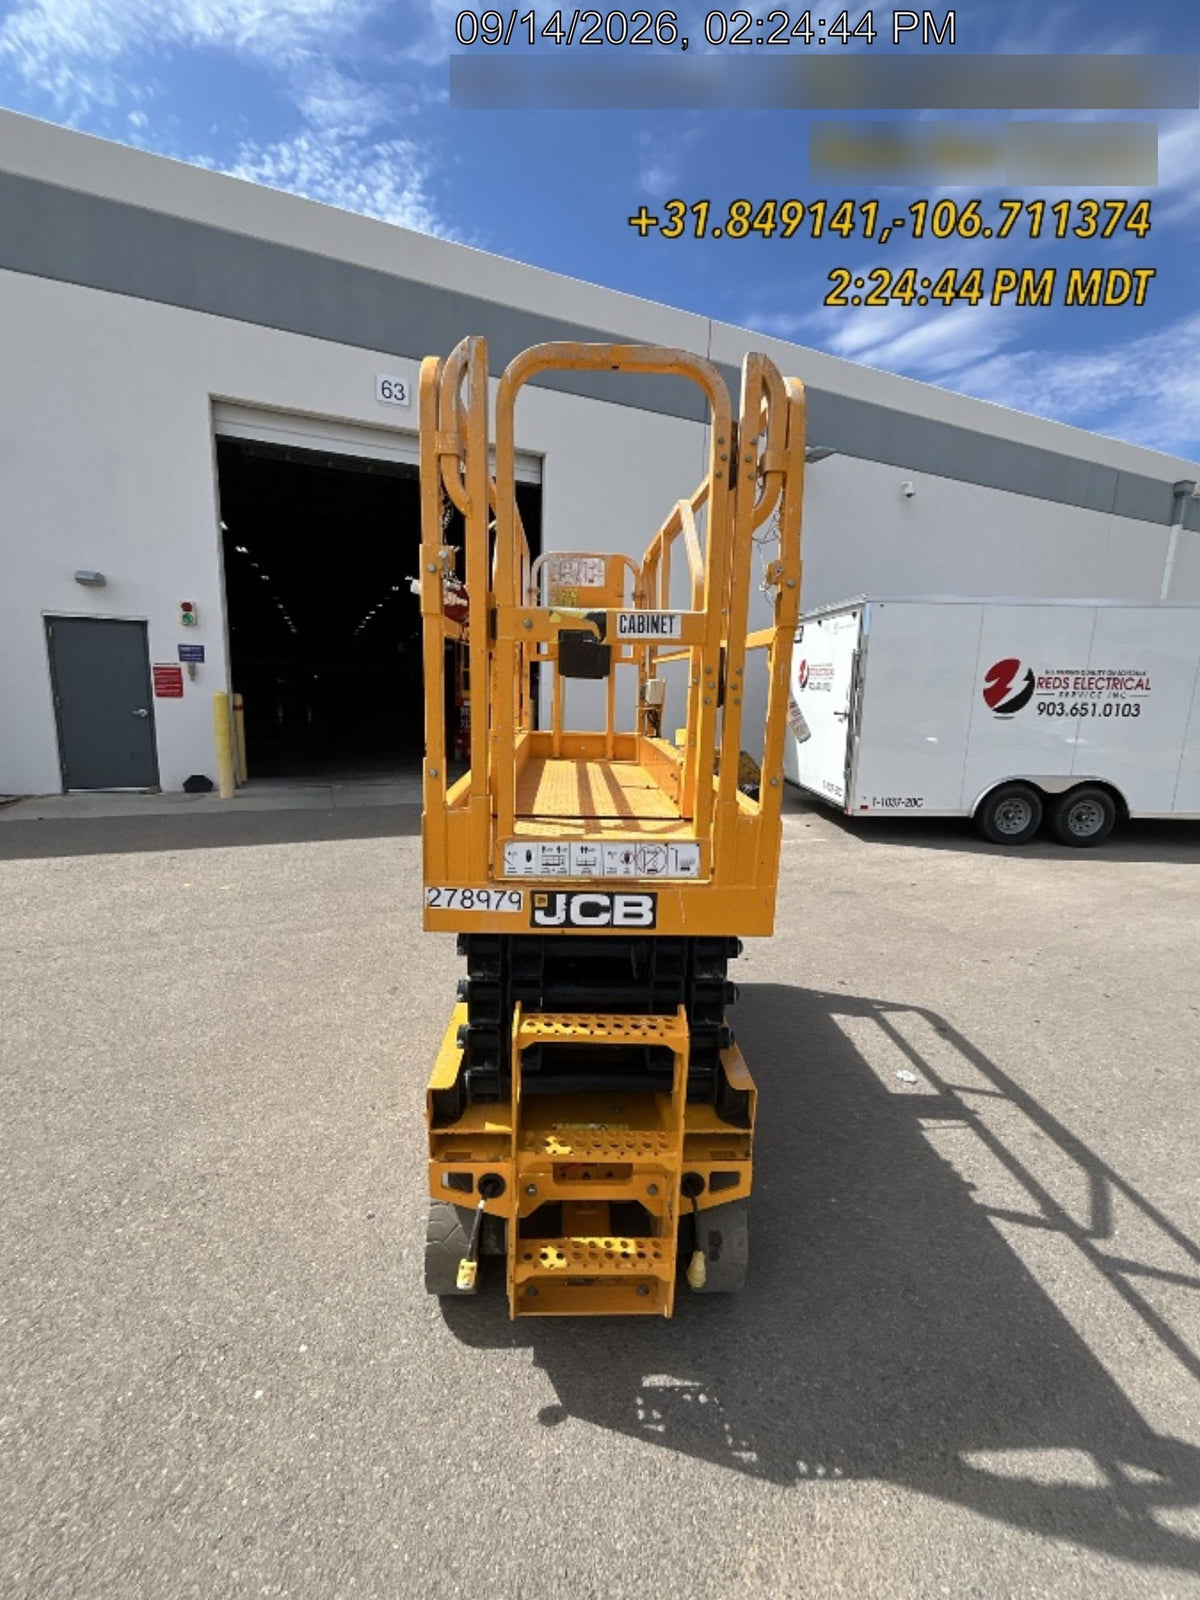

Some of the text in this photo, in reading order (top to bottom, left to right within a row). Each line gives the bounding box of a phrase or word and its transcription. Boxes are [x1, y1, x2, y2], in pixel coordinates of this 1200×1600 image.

[381, 379, 406, 401] 63
[619, 614, 676, 634] CABINET
[1036, 676, 1152, 691] REDS ELECTRICAL
[1036, 701, 1141, 717] 903.651.0103
[426, 887, 523, 911] 278979
[533, 893, 654, 926] JCB
